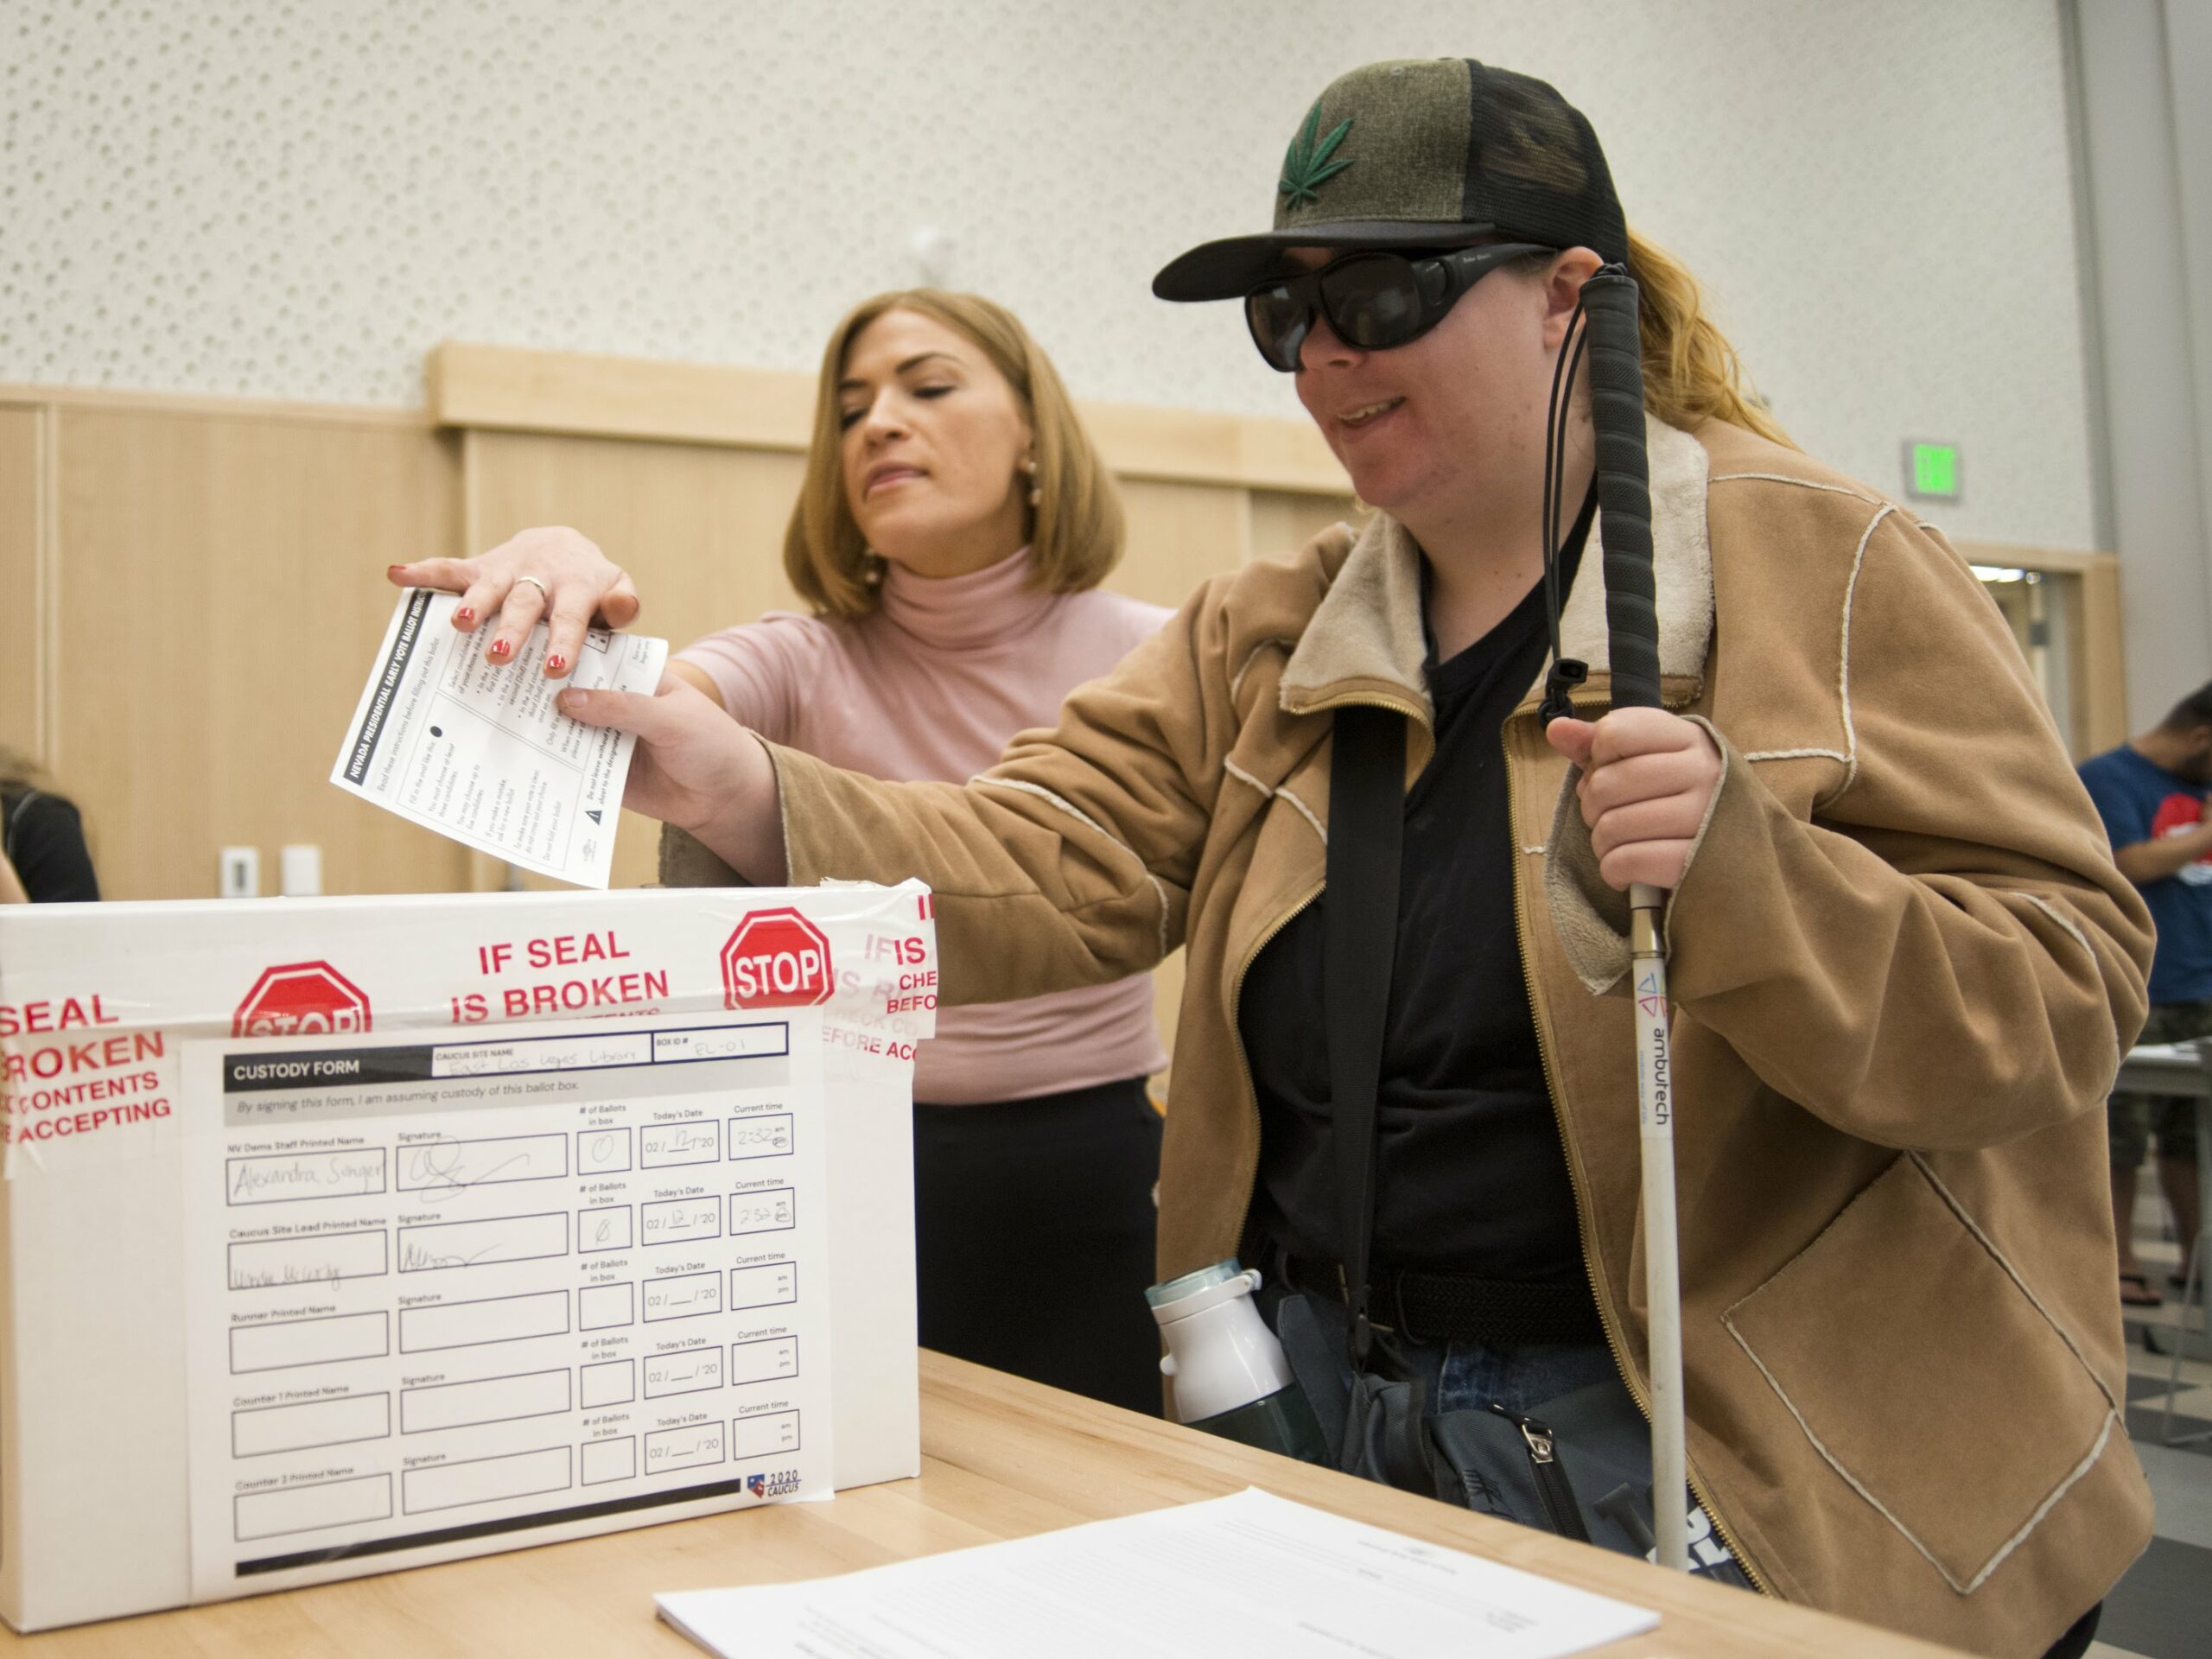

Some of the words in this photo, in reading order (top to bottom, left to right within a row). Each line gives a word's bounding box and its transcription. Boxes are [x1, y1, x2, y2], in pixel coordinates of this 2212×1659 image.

[350, 743, 370, 778] NEVADA
[363, 688, 391, 742] PRESIDENTIAL
[385, 661, 400, 687] EARLY
[395, 641, 408, 660] VOTE
[402, 616, 417, 642] BALLOT
[378, 773, 389, 791] Read
[385, 757, 395, 773] these
[392, 721, 408, 755] instructions
[404, 698, 416, 720] before
[411, 679, 426, 696] filling
[424, 656, 433, 666] this
[587, 791, 594, 799] Do
[592, 760, 601, 778] leave
[600, 732, 611, 758] without
[598, 788, 607, 804] sheet
[608, 730, 624, 766] designated
[479, 944, 512, 975] IF
[527, 931, 630, 969] SEAL
[894, 938, 926, 965] IS
[735, 950, 822, 998] STOP
[451, 997, 489, 1023] IS
[504, 970, 670, 1018] BROKEN
[0, 994, 119, 1037] SEAL
[234, 1063, 310, 1080] CUSTODY
[314, 1060, 359, 1075] FORM
[1654, 1028, 1669, 1125] ambutech
[238, 1101, 253, 1114] By
[257, 1100, 298, 1114] signing
[302, 1098, 322, 1109] this
[326, 1096, 354, 1107] form,
[365, 1096, 382, 1104] am
[385, 1090, 438, 1103] assuming
[441, 1086, 486, 1099] custody
[489, 1085, 499, 1096] of
[503, 1084, 522, 1095] this
[525, 1083, 555, 1093] ballot
[734, 1104, 763, 1113] Current
[18, 1098, 171, 1142] ACCEPTING
[398, 1132, 442, 1142] Signature
[275, 1141, 297, 1150] Staff
[588, 1184, 597, 1192] of
[599, 1183, 626, 1192] Ballots
[735, 1180, 765, 1189] Current
[397, 1214, 441, 1224] Signature
[230, 1229, 269, 1238] Caucus
[272, 1226, 292, 1235] Site
[295, 1223, 320, 1232] Lead
[322, 1220, 357, 1229] Printed
[590, 1262, 599, 1270] of
[601, 1260, 628, 1268] Ballots
[736, 1255, 766, 1264] Current
[656, 1265, 684, 1274] Today's
[398, 1295, 441, 1306] Signature
[232, 1313, 268, 1322] Runner
[271, 1307, 306, 1317] Printed
[738, 1329, 767, 1338] Current
[601, 1338, 628, 1346] Ballots
[657, 1341, 686, 1350] Today's
[402, 1375, 445, 1387] Signature
[233, 1395, 276, 1407] Counter
[285, 1389, 320, 1399] Printed
[739, 1403, 769, 1414] Current
[602, 1414, 629, 1423] Ballots
[658, 1416, 687, 1426] Today's
[404, 1454, 446, 1469] Signature
[236, 1479, 278, 1491] Counter
[289, 1471, 325, 1481] Printed
[770, 1470, 799, 1484] 2020
[768, 1483, 798, 1497] CAUCUS
